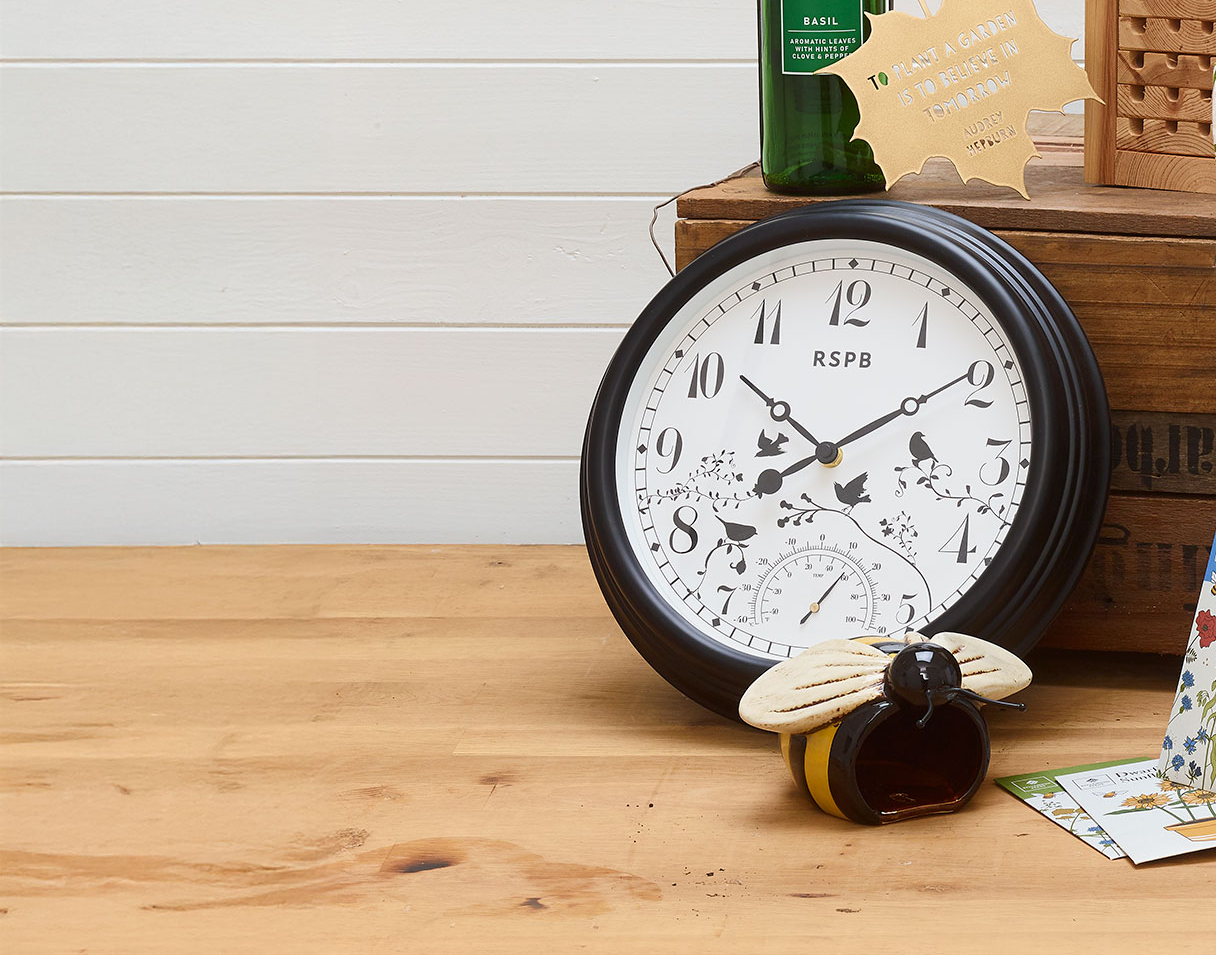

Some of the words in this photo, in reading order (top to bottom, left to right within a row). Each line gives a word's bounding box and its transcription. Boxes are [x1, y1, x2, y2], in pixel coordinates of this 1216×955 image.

[803, 17, 839, 25] BASIL
[867, 72, 889, 90] TO
[892, 46, 939, 81] PLANT
[945, 42, 957, 58] A
[958, 10, 1018, 49] GARDEN
[897, 88, 913, 107] IS
[914, 77, 937, 98] TO
[938, 48, 998, 88] BELIEVE
[1000, 38, 1019, 57] IN
[922, 70, 1013, 124] TOMORROW
[963, 111, 1004, 138] AUDREY
[966, 125, 1017, 156] HEPBURN
[826, 279, 873, 328] 12
[751, 298, 782, 345] 11
[911, 301, 928, 348] 1
[813, 350, 873, 369] RSPB
[684, 351, 725, 400] 10
[964, 359, 995, 409] 2
[655, 427, 683, 474] 9
[978, 438, 1013, 487] 3
[668, 505, 702, 554] 8
[785, 538, 797, 546] -10
[937, 513, 977, 564] 4
[849, 542, 858, 550] 10
[755, 558, 769, 566] -20
[872, 563, 882, 571] 20
[716, 584, 737, 615] 7
[739, 584, 752, 592] -30
[881, 594, 891, 602] 30
[733, 615, 748, 624] -40
[896, 593, 919, 625] 5
[876, 626, 887, 634] 40
[1120, 772, 1156, 783] Sunfl
